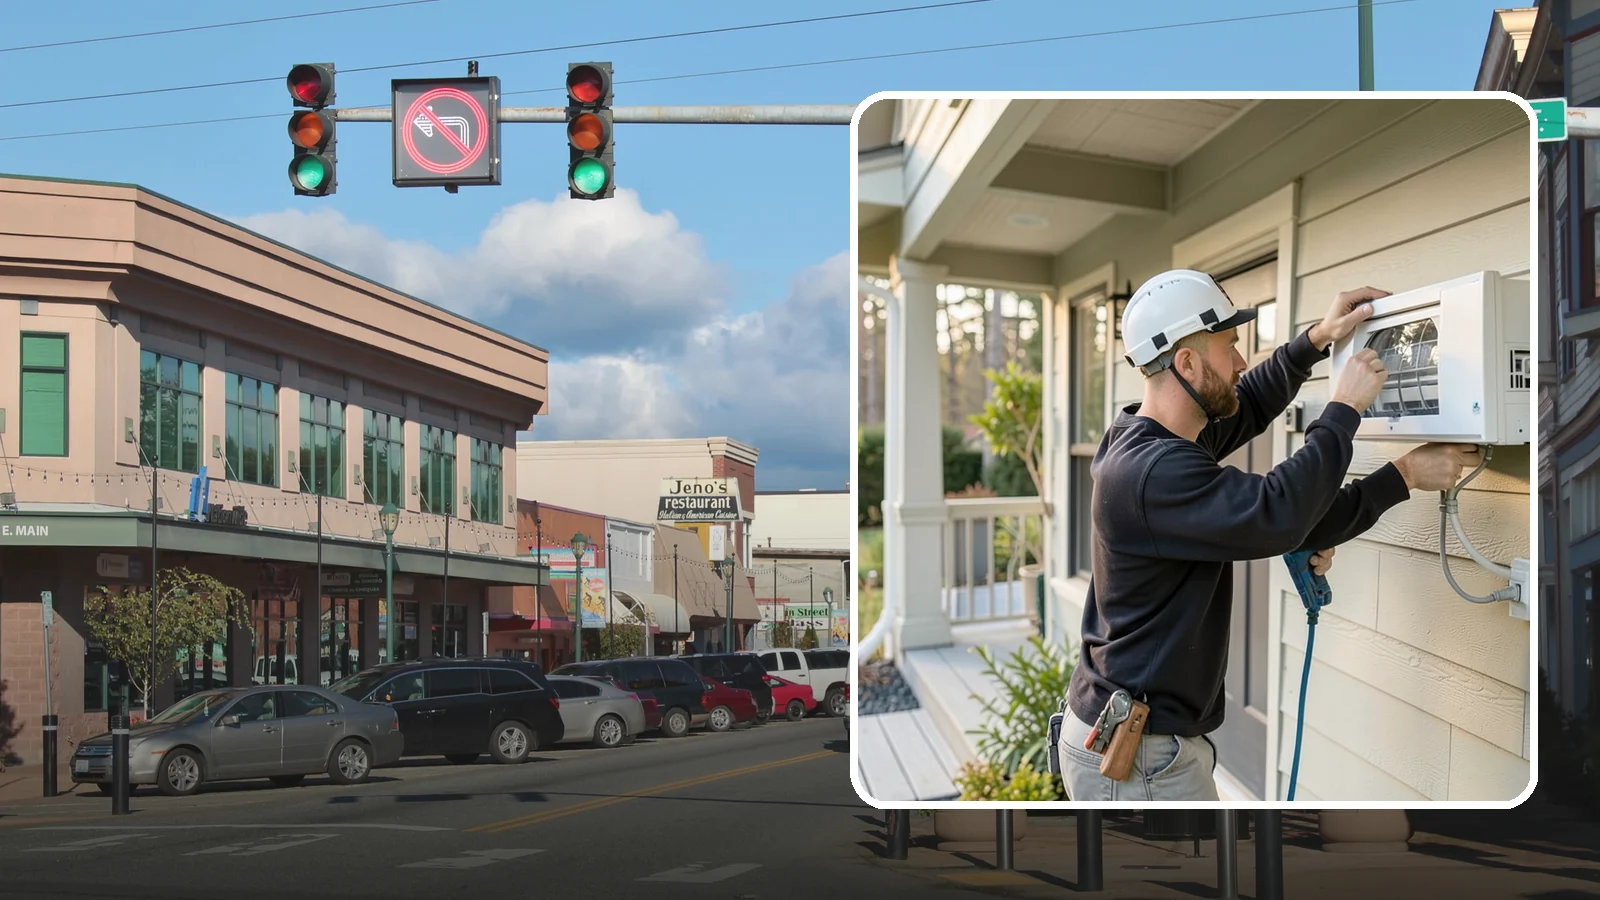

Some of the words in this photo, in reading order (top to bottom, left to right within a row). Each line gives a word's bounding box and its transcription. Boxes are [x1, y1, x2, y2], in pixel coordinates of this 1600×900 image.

[669, 480, 728, 494] Jeno's
[665, 496, 731, 508] restaurant
[686, 510, 715, 519] American
[715, 510, 737, 518] Cuisine
[2, 525, 13, 536] E.
[15, 525, 49, 536] MAIN
[797, 608, 828, 616] Street
